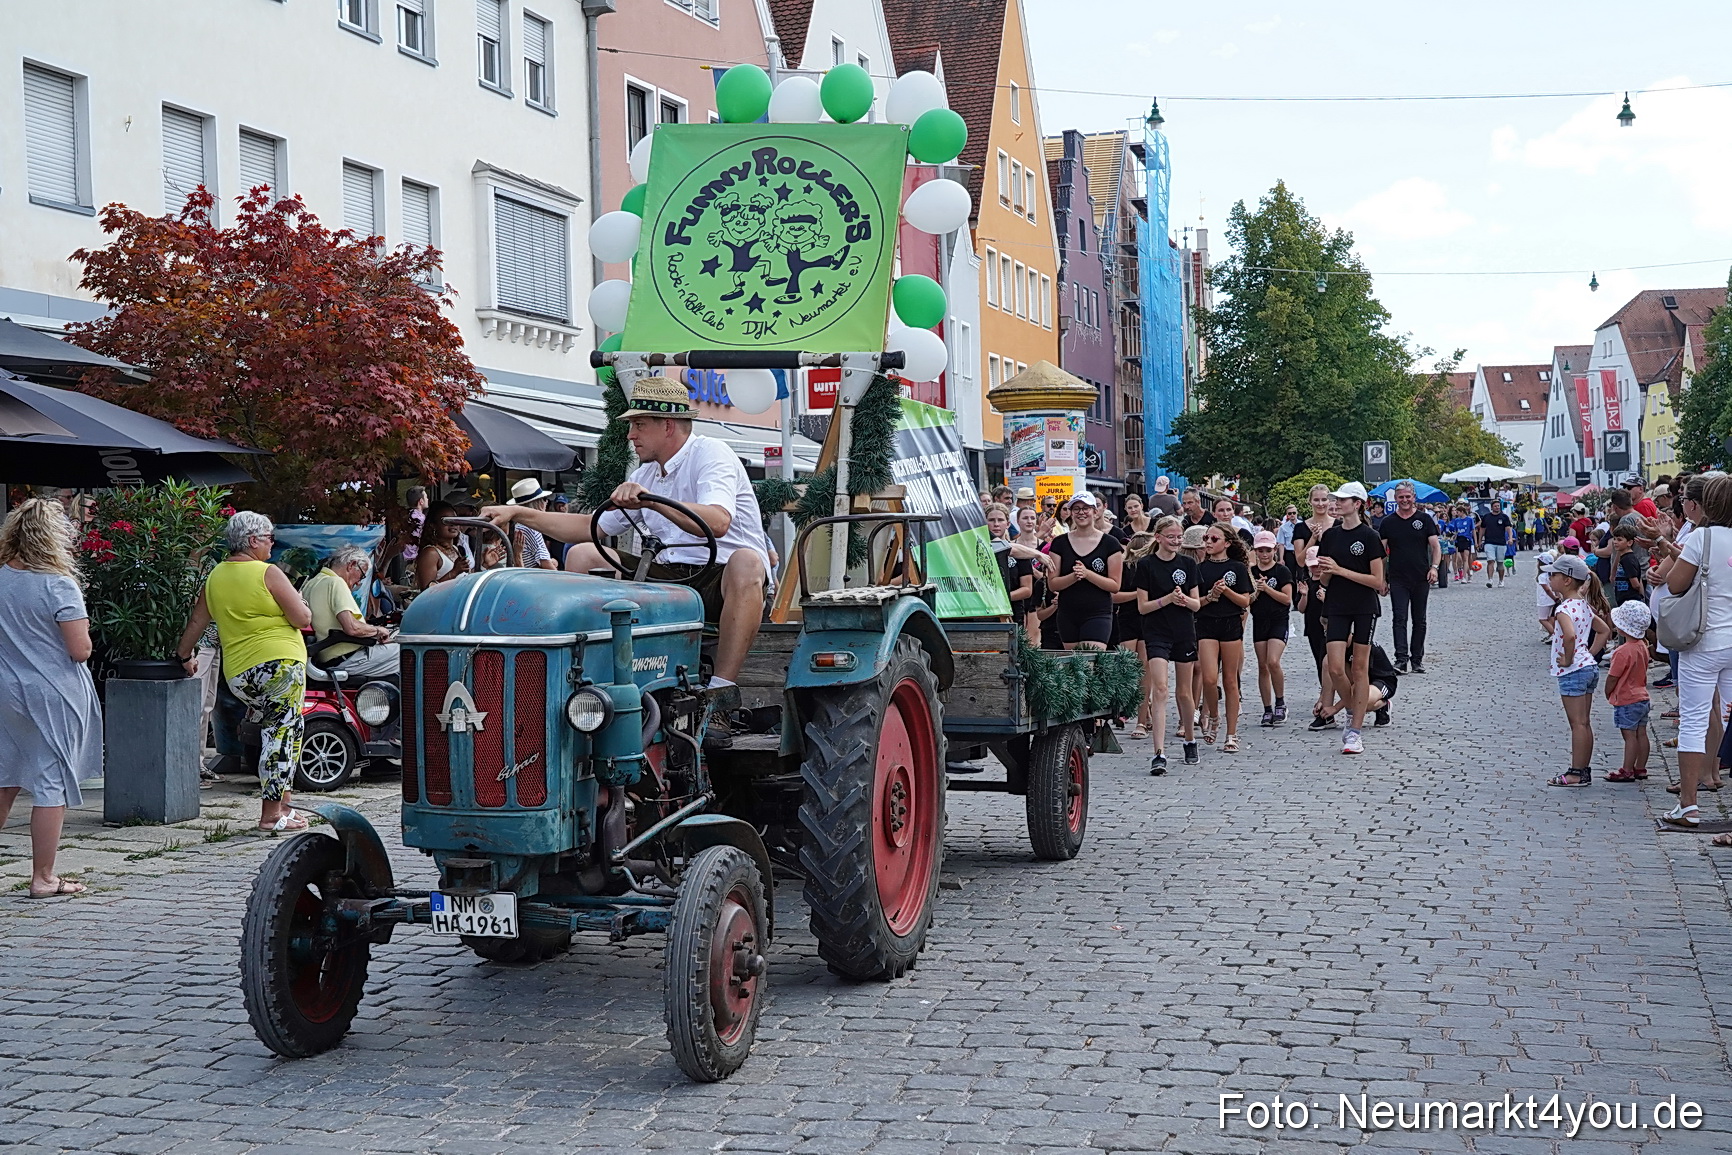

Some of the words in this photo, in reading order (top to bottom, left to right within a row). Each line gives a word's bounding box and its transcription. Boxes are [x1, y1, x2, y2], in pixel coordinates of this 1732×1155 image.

[741, 320, 777, 340] DJK
[789, 281, 851, 328] Neumarkt
[632, 652, 668, 678] anomag
[450, 895, 475, 913] NM
